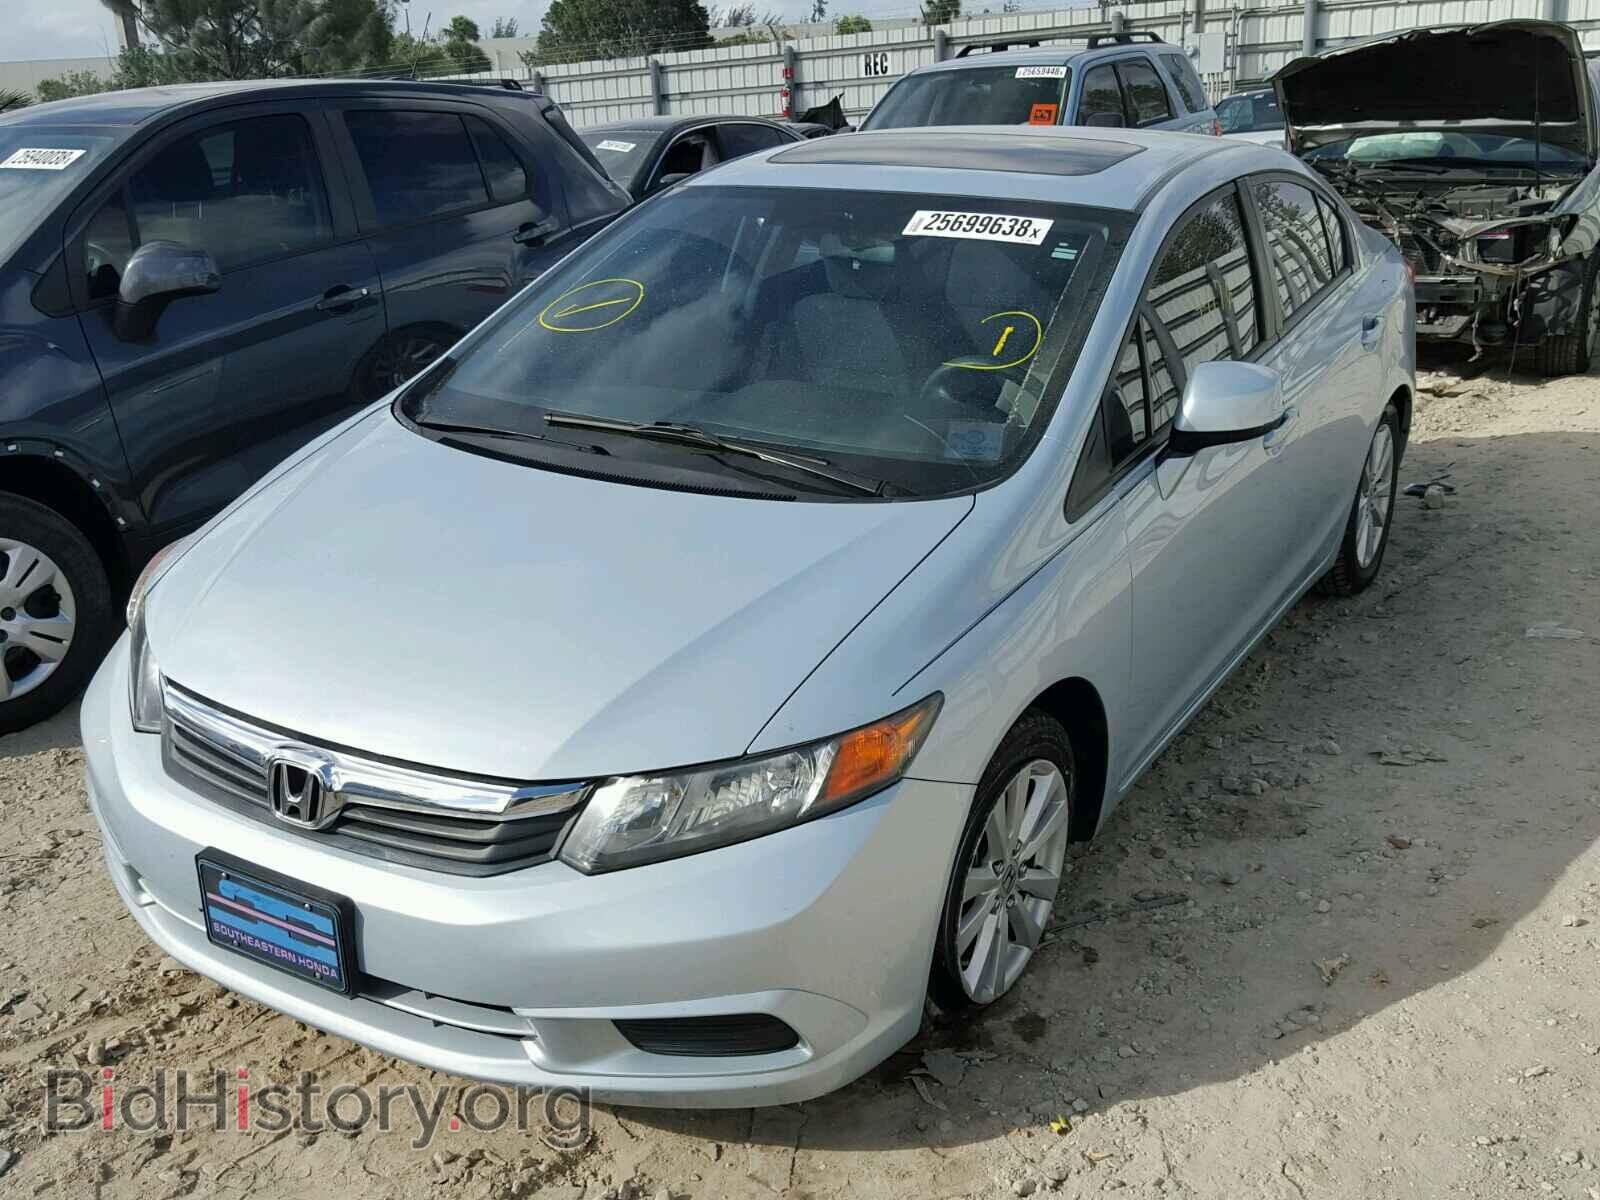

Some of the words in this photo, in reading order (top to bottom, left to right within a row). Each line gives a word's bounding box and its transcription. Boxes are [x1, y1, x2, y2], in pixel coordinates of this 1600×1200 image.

[864, 52, 888, 75] REC
[212, 921, 297, 963] SOUTHEASTERN
[299, 954, 338, 978] HONDA
